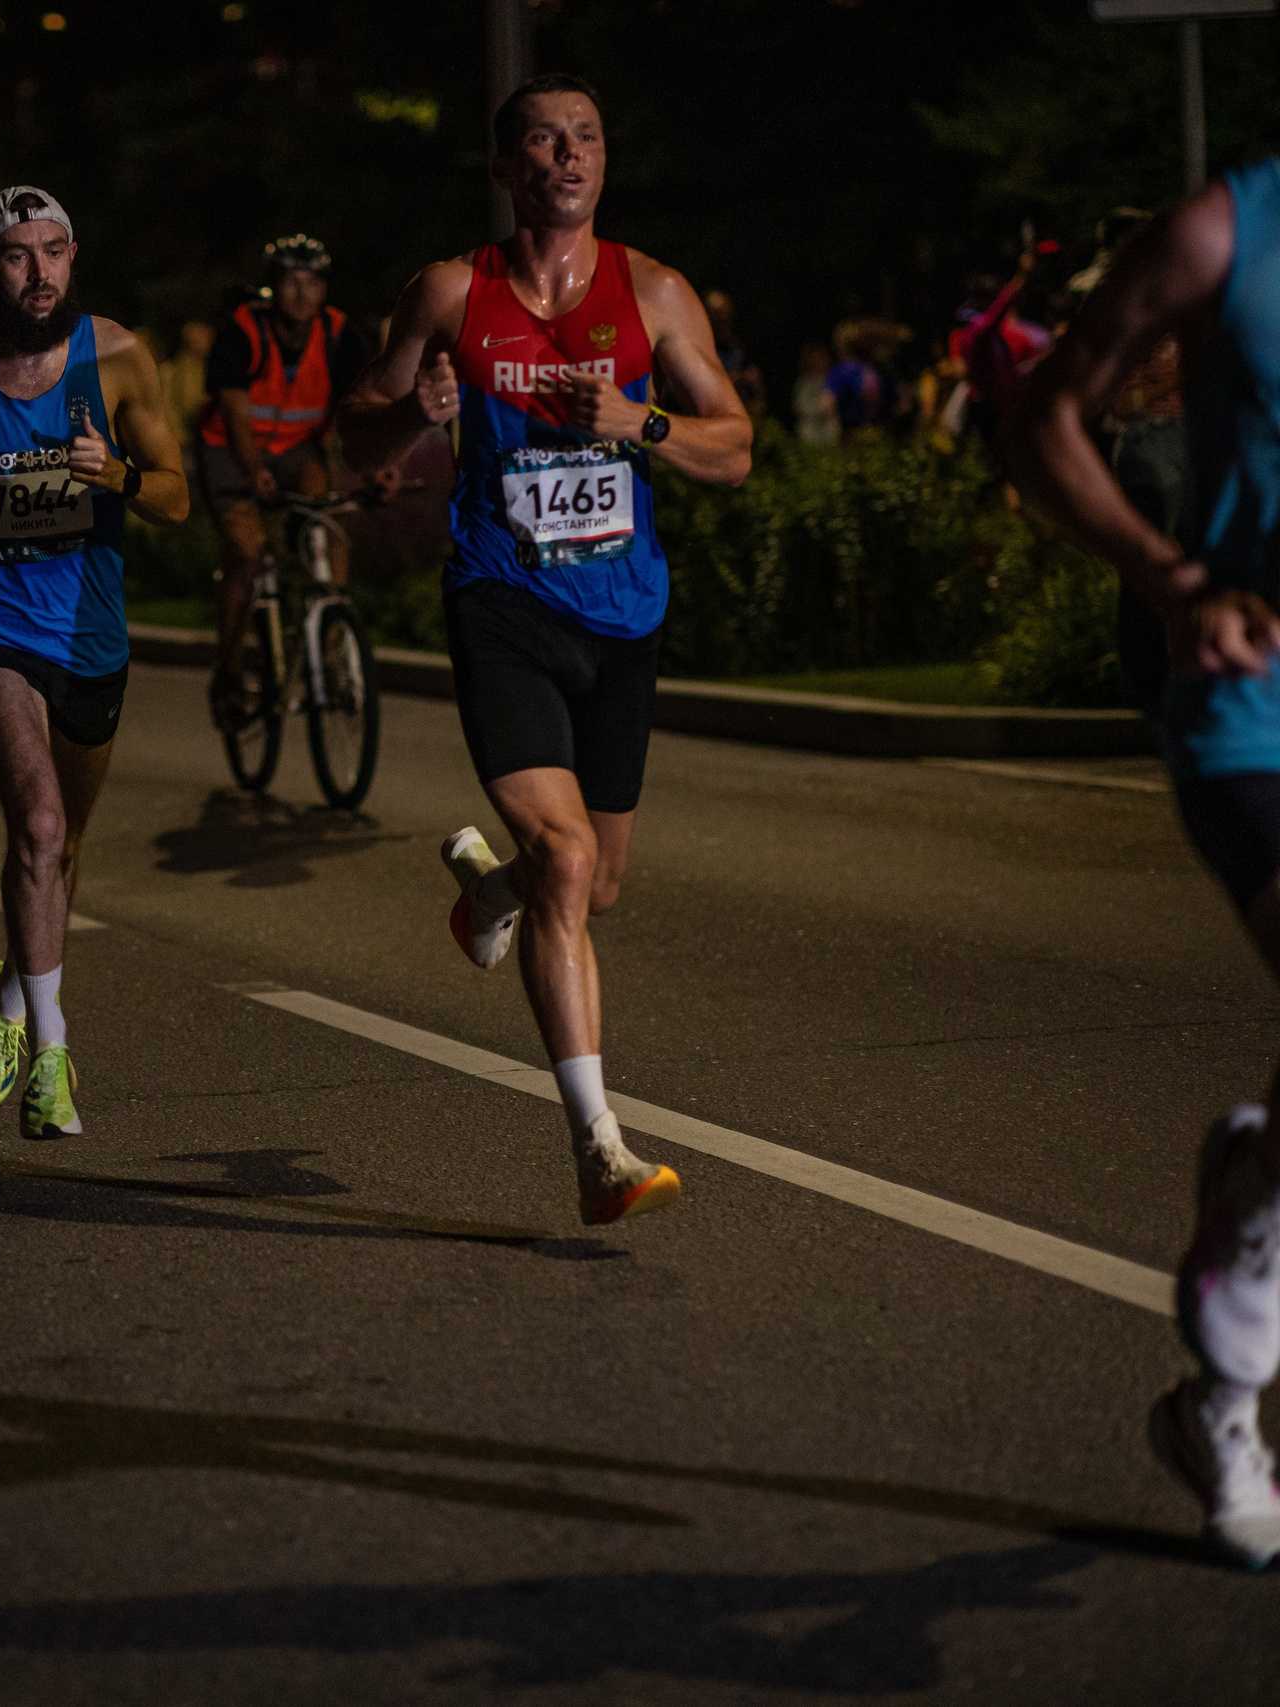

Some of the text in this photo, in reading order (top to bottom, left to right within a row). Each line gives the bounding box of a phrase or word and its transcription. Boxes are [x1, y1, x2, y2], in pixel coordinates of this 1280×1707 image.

[526, 475, 617, 519] 1465
[10, 517, 58, 532] НИКИТА
[533, 514, 610, 535] КОНСТАНТИН
